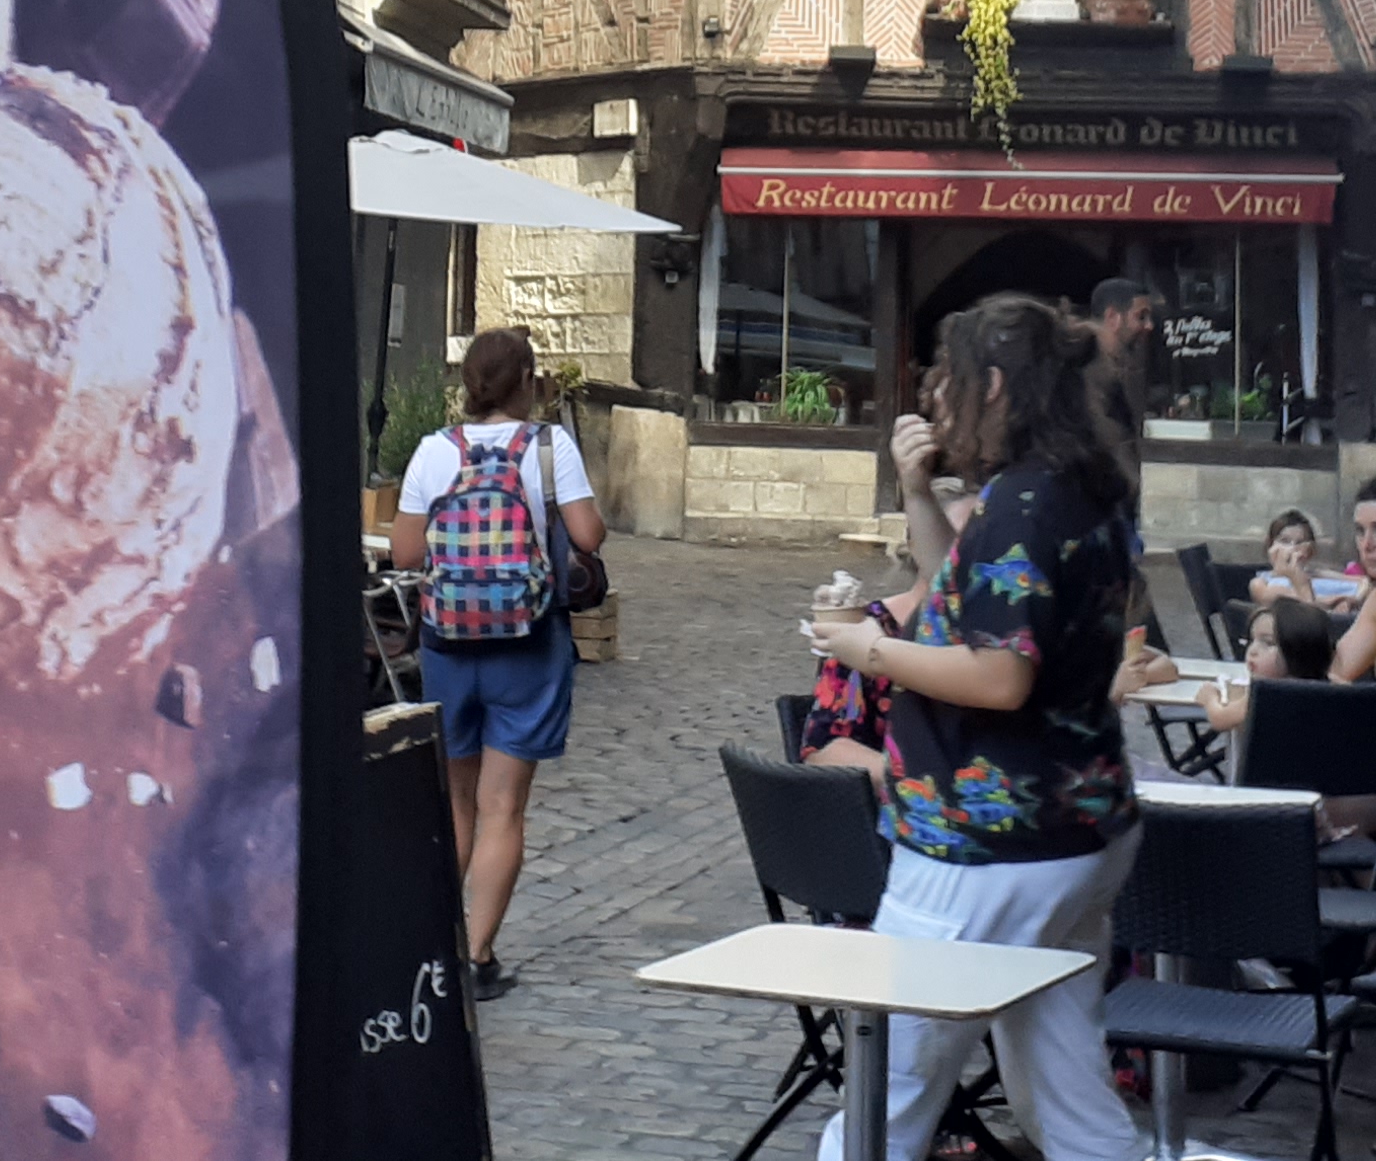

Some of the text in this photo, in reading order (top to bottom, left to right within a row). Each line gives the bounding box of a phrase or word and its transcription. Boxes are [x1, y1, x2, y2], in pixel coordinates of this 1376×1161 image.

[768, 109, 1300, 148] Restaurant Lonard de Vinci
[755, 178, 1303, 217] Restaurant Léonard de Vinci
